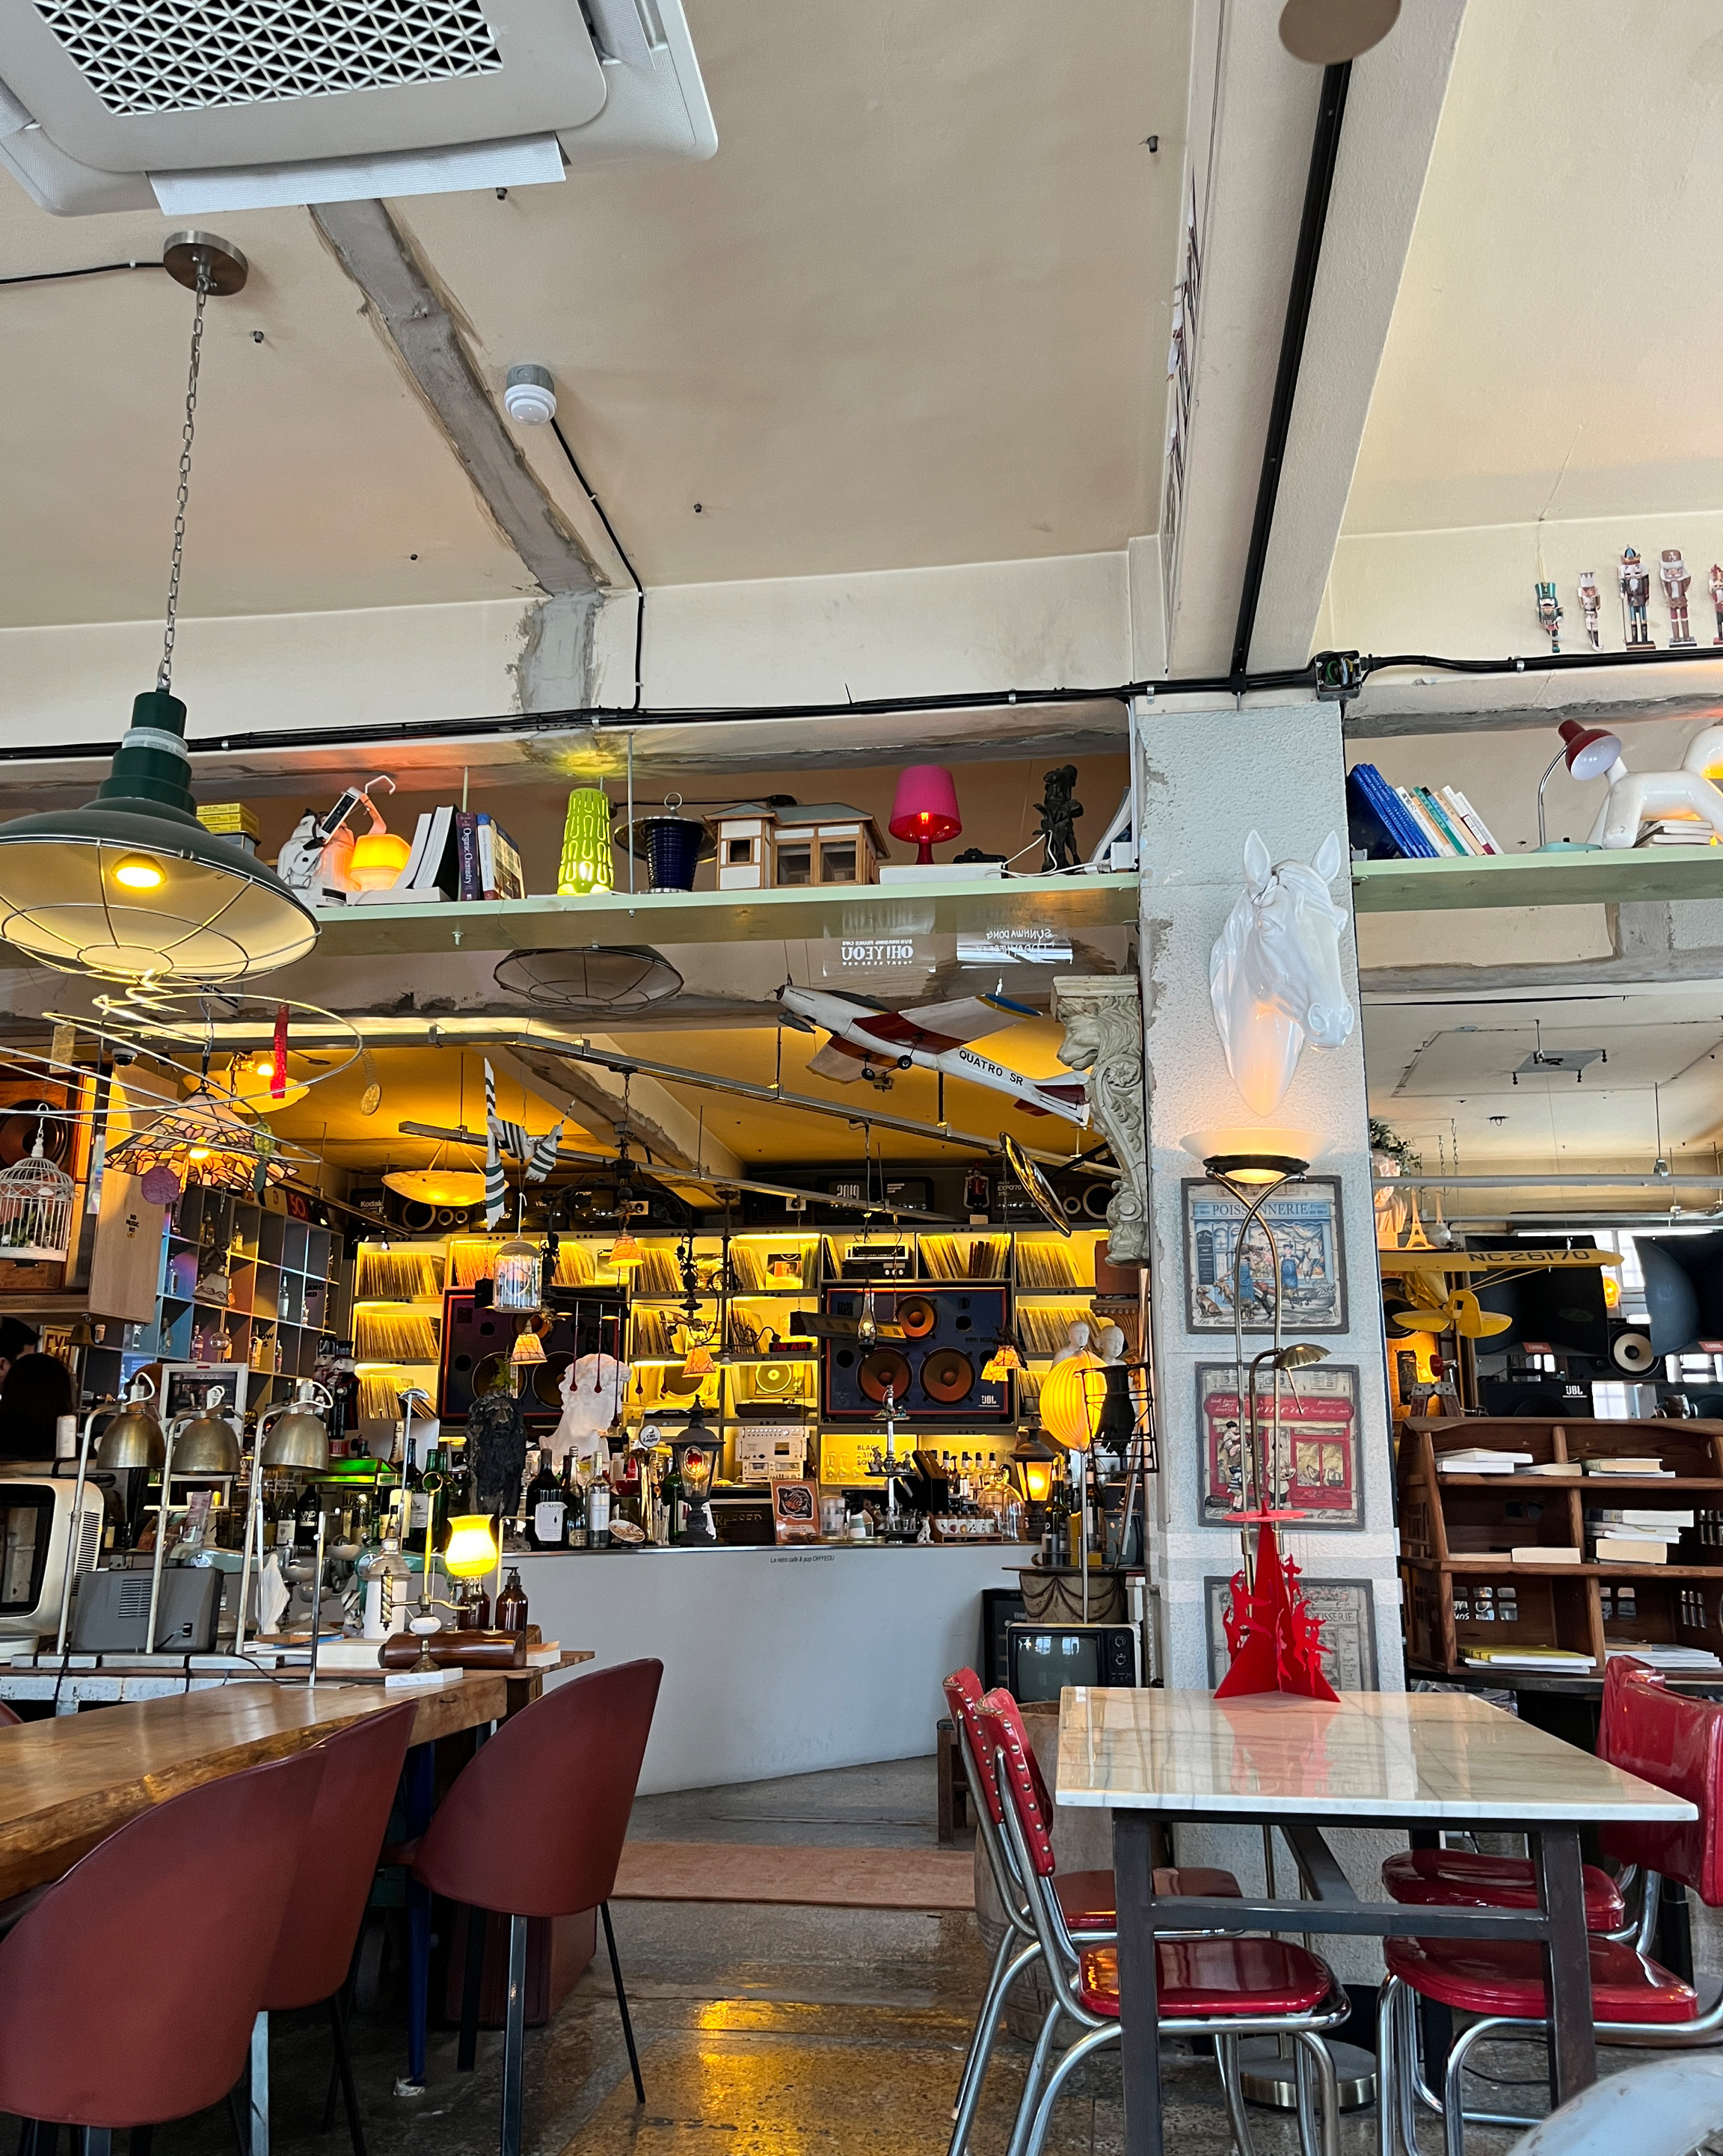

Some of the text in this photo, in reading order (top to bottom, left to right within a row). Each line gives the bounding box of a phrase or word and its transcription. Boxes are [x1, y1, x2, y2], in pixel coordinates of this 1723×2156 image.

[461, 827, 472, 853] Organic
[464, 853, 473, 884] Chemistry
[959, 1050, 1024, 1087] QUATRO SR
[1212, 1203, 1309, 1216] POISSNNERIE
[790, 1342, 807, 1351] AIR
[1565, 1385, 1583, 1395] JBL
[981, 1395, 997, 1404] JBL
